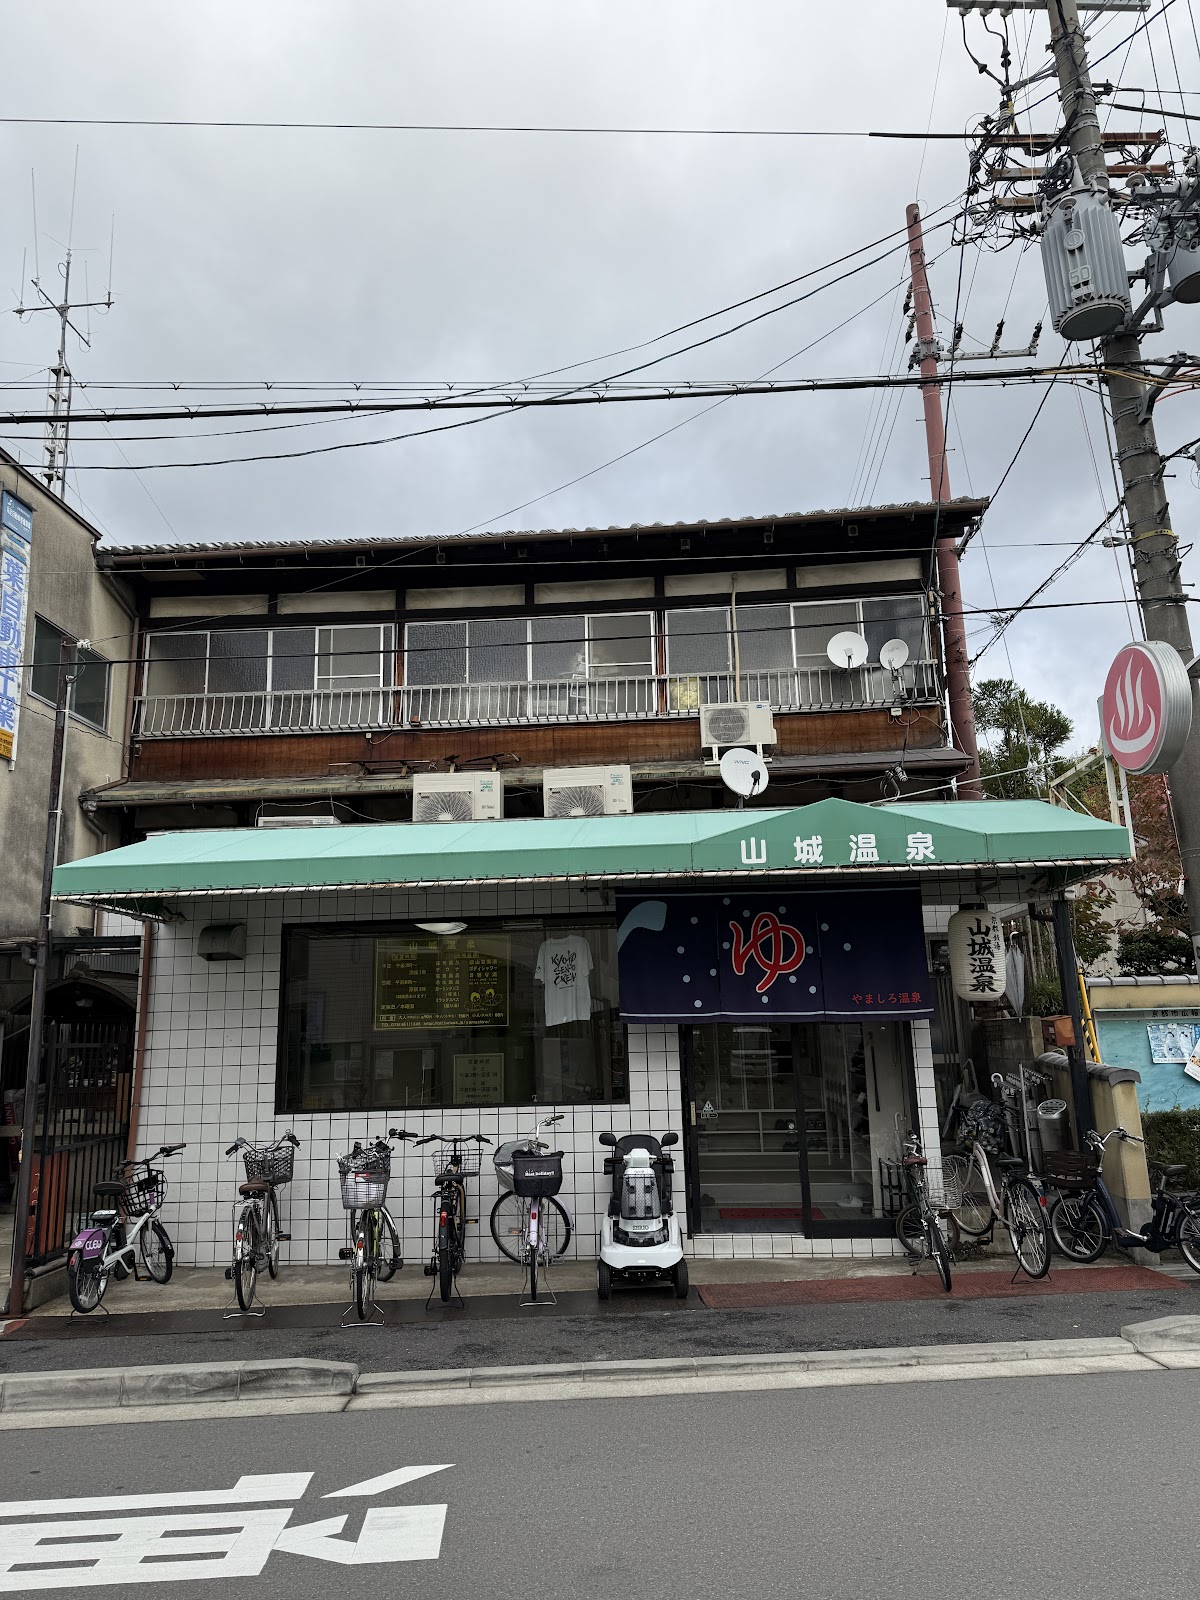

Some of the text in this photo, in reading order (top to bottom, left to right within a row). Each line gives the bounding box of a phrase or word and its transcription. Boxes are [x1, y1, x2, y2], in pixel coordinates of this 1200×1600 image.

[1070, 266, 1091, 285] 50
[740, 832, 936, 864] 山城温泉
[729, 911, 806, 993] ゆ
[966, 917, 998, 993] 山城温泉
[852, 991, 922, 1005] やましろ温泉
